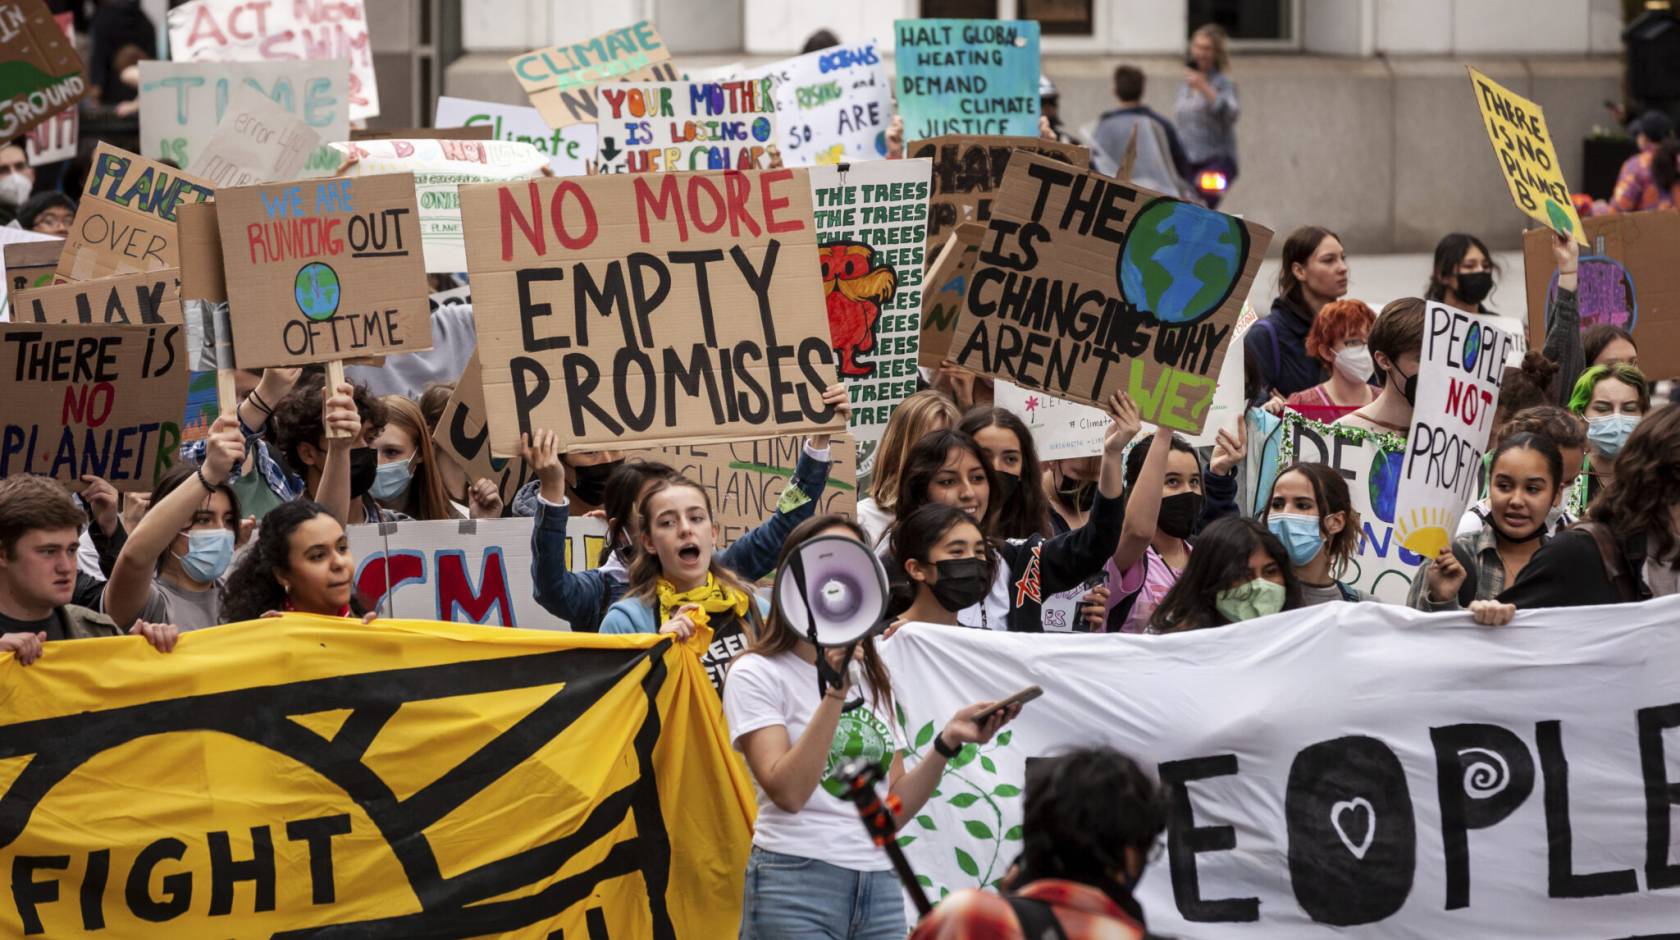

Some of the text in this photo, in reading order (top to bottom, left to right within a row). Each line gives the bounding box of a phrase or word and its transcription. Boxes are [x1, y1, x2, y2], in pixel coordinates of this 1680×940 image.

[187, 2, 271, 46] ACT
[901, 26, 952, 47] HALT
[516, 20, 661, 82] CLIMATE
[917, 50, 1003, 67] HEATING
[0, 75, 84, 137] GROUND
[602, 87, 674, 119] YOUR
[690, 79, 775, 116] MOTHER
[903, 75, 988, 96] DEMAND
[960, 97, 1035, 115] CLIMATE
[625, 121, 748, 145] IS LOSING
[838, 102, 880, 136] ARE
[919, 118, 1009, 139] JUSTICE
[1477, 80, 1545, 144] THERE
[1490, 118, 1551, 171] IS NO
[89, 152, 214, 222] PLANET
[260, 180, 353, 220] WE ARE
[815, 181, 928, 207] THE TREES
[1028, 163, 1138, 243] THE
[1501, 148, 1571, 206] PLANET
[1514, 178, 1537, 211] B
[82, 214, 168, 266] OVER
[246, 208, 410, 264] RUNNING OUT
[498, 168, 805, 262] NO MORE
[813, 208, 857, 229] THE
[860, 203, 927, 224] TREES
[858, 224, 925, 245] TREES
[873, 247, 924, 268] REES
[979, 219, 1052, 271] IS
[516, 238, 780, 352] EMPTY
[968, 267, 1151, 357] CHANGING
[1154, 322, 1230, 375] WHY
[5, 331, 122, 383] THERE
[1429, 307, 1512, 388] PEOPLE
[510, 337, 836, 447] PROMISES
[848, 380, 916, 403] TREES
[956, 320, 1217, 432] AREN'T WE?
[62, 382, 115, 427] NO
[1445, 375, 1493, 432] NOT
[0, 422, 160, 481] PLANET
[1407, 422, 1482, 502] PROFIT
[851, 708, 895, 753] FUURE
[1025, 701, 1680, 925] EOPLE
[11, 814, 352, 935] FIGHT
